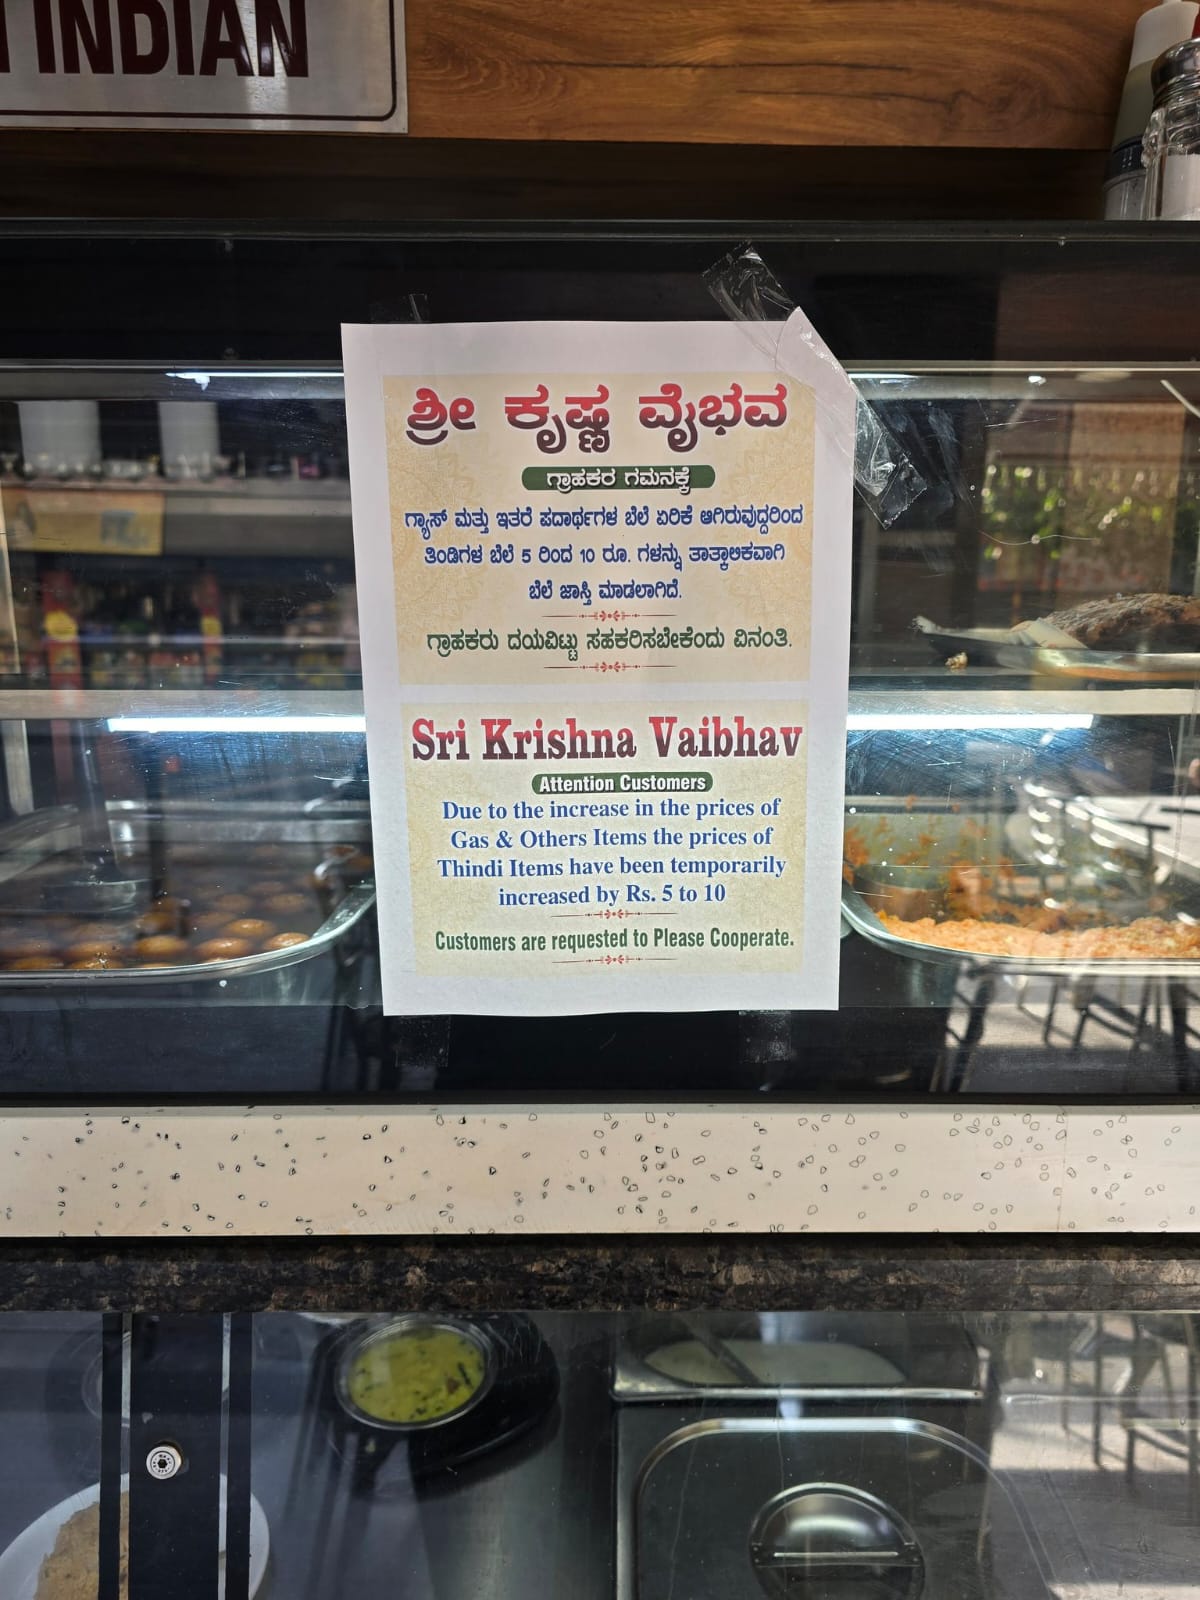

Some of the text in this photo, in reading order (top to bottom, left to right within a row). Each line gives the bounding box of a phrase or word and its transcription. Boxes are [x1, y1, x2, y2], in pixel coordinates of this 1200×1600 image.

[32, 0, 309, 78] INDIAN
[405, 382, 788, 455] ಶ್ರೀ ಕೃಷ್ಣ ವೈಭವ
[546, 466, 692, 495] ಗ್ರಾಹಕರ ಗಮನಕ್ಕೆ
[404, 503, 804, 541] ಗ್ಯಾಸ್ ಮತ್ತು ಇತರೆ ಪದಾರ್ಥಗಳ ಬೆಲೆ ಏರಿಕೆ ಆಗಿರುವುದ್ದರಿಂದ
[424, 541, 786, 572] ತಿಂಡಿಗಳ ಬೆಲೆ 5 ರಿಂದ 10 ರೂ. ಗಳನ್ನು ತಾತ್ಕಾಲಿಕವಾಗಿ
[528, 578, 682, 606] ಬೆಲೆ ಜಾಸ್ತಿ ಮಾಡಲಾಗಿದೆ.
[426, 625, 793, 662] ಗ್ರಾಹಕರು ದಯವಿಟ್ಟು ಸಹಕರಿಸಬೇಕೆಂದು ವಿನಂತಿ.
[411, 715, 803, 761] Sri Krishna Vaibhav
[539, 773, 706, 795] Attention Customers
[442, 797, 782, 821] Due to the increase in the prices of
[450, 826, 775, 850] Gas & Others Items the prices of
[436, 855, 787, 878] Thindi Items have been temporarily
[498, 883, 726, 907] increased by Rs. 5 to 10
[435, 927, 795, 954] Customers are requested to Please Cooperate.
